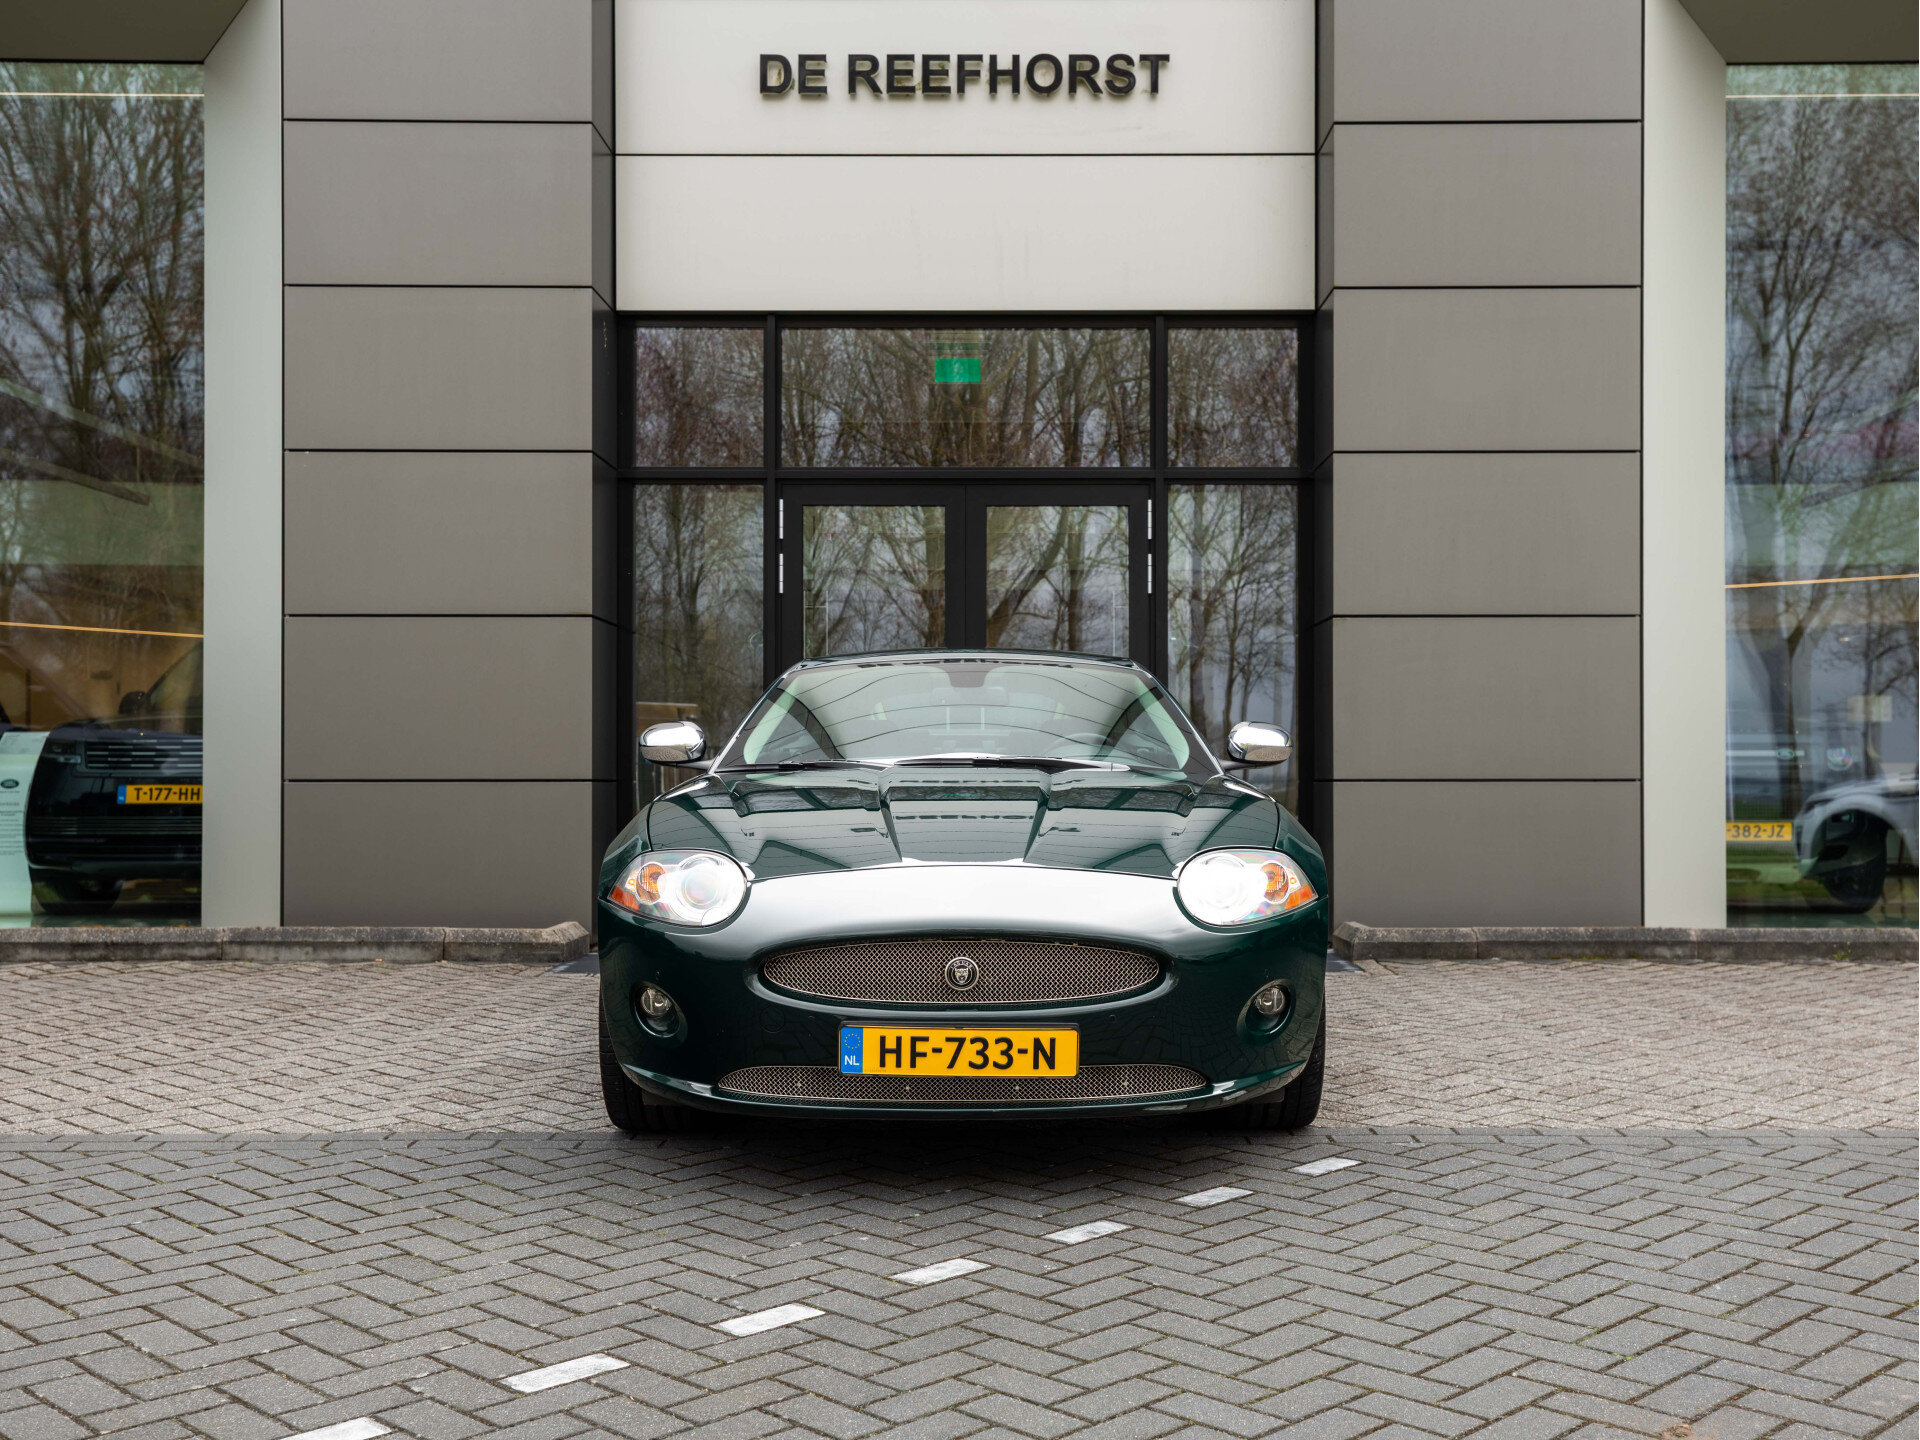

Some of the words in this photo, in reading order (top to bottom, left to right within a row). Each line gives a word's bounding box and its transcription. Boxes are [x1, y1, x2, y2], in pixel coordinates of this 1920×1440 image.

[759, 53, 828, 96] DE
[847, 53, 1171, 96] REEFHORST
[133, 787, 201, 801] T-177-HH
[844, 1054, 860, 1066] NL
[879, 1035, 1056, 1070] HF-733-N
